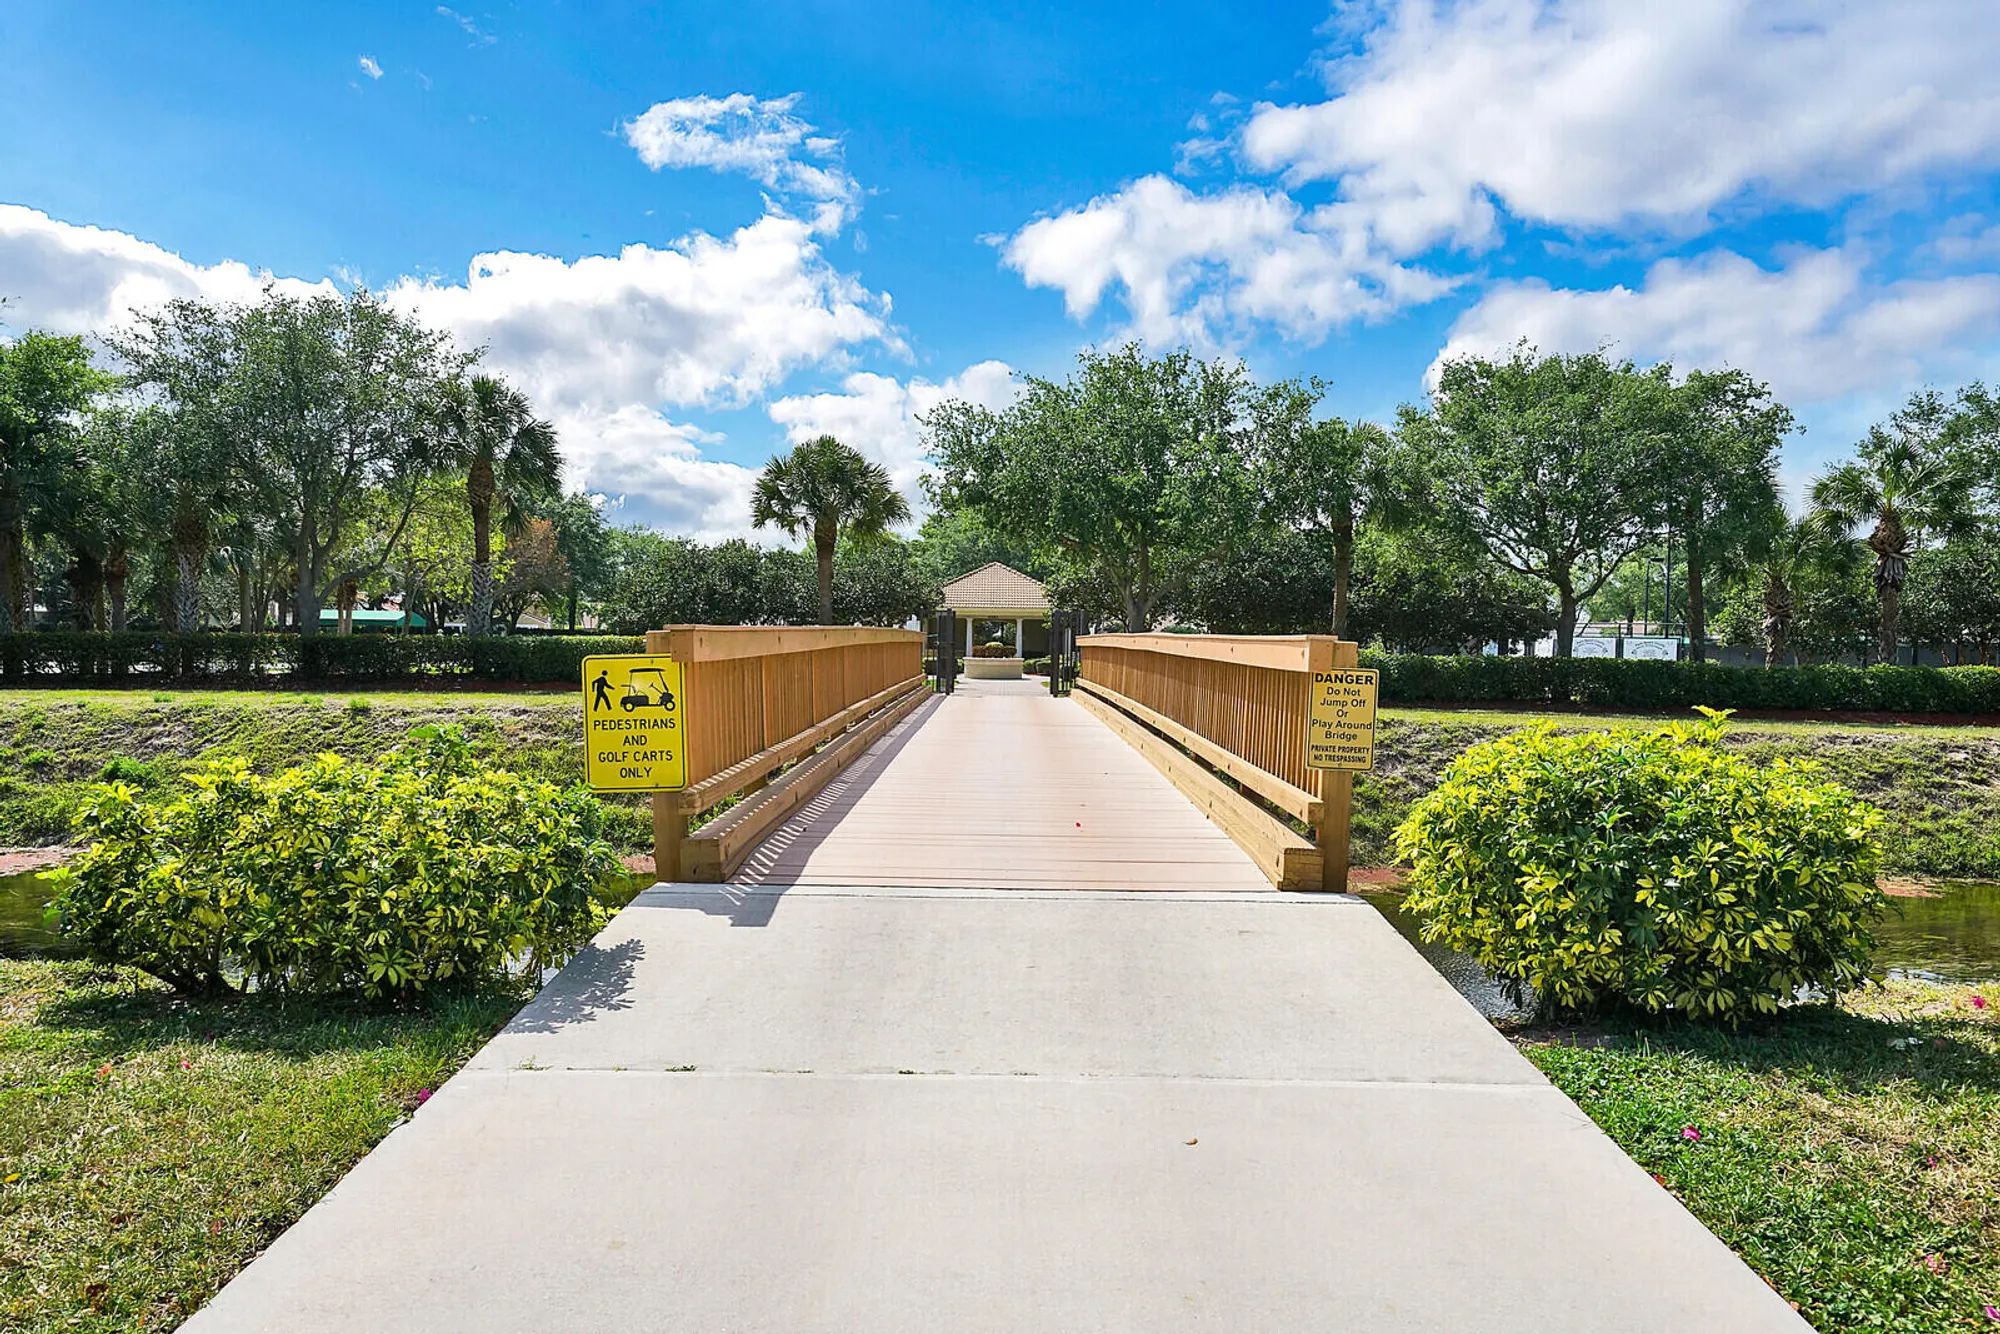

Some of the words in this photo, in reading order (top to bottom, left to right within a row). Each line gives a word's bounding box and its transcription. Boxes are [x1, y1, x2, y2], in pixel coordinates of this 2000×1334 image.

[1315, 673, 1374, 685] DANGER
[1327, 686, 1340, 696] Do
[1343, 687, 1361, 696] Not
[1320, 698, 1348, 708] Jump
[1351, 699, 1366, 708] Off
[1336, 709, 1349, 718] Or
[593, 718, 676, 730] PEDESTRIANS
[1312, 719, 1333, 729] Play
[1335, 720, 1372, 730] Around
[623, 735, 648, 746] AND
[1325, 730, 1358, 742] Bridge
[1311, 744, 1336, 753] PRIVATE
[1338, 745, 1370, 754] PROPERTY
[598, 751, 629, 763] GOLF
[633, 750, 673, 762] CARTS
[1314, 754, 1323, 762] NO
[1325, 754, 1366, 763] TRESPASSING
[619, 767, 652, 779] ONLY
